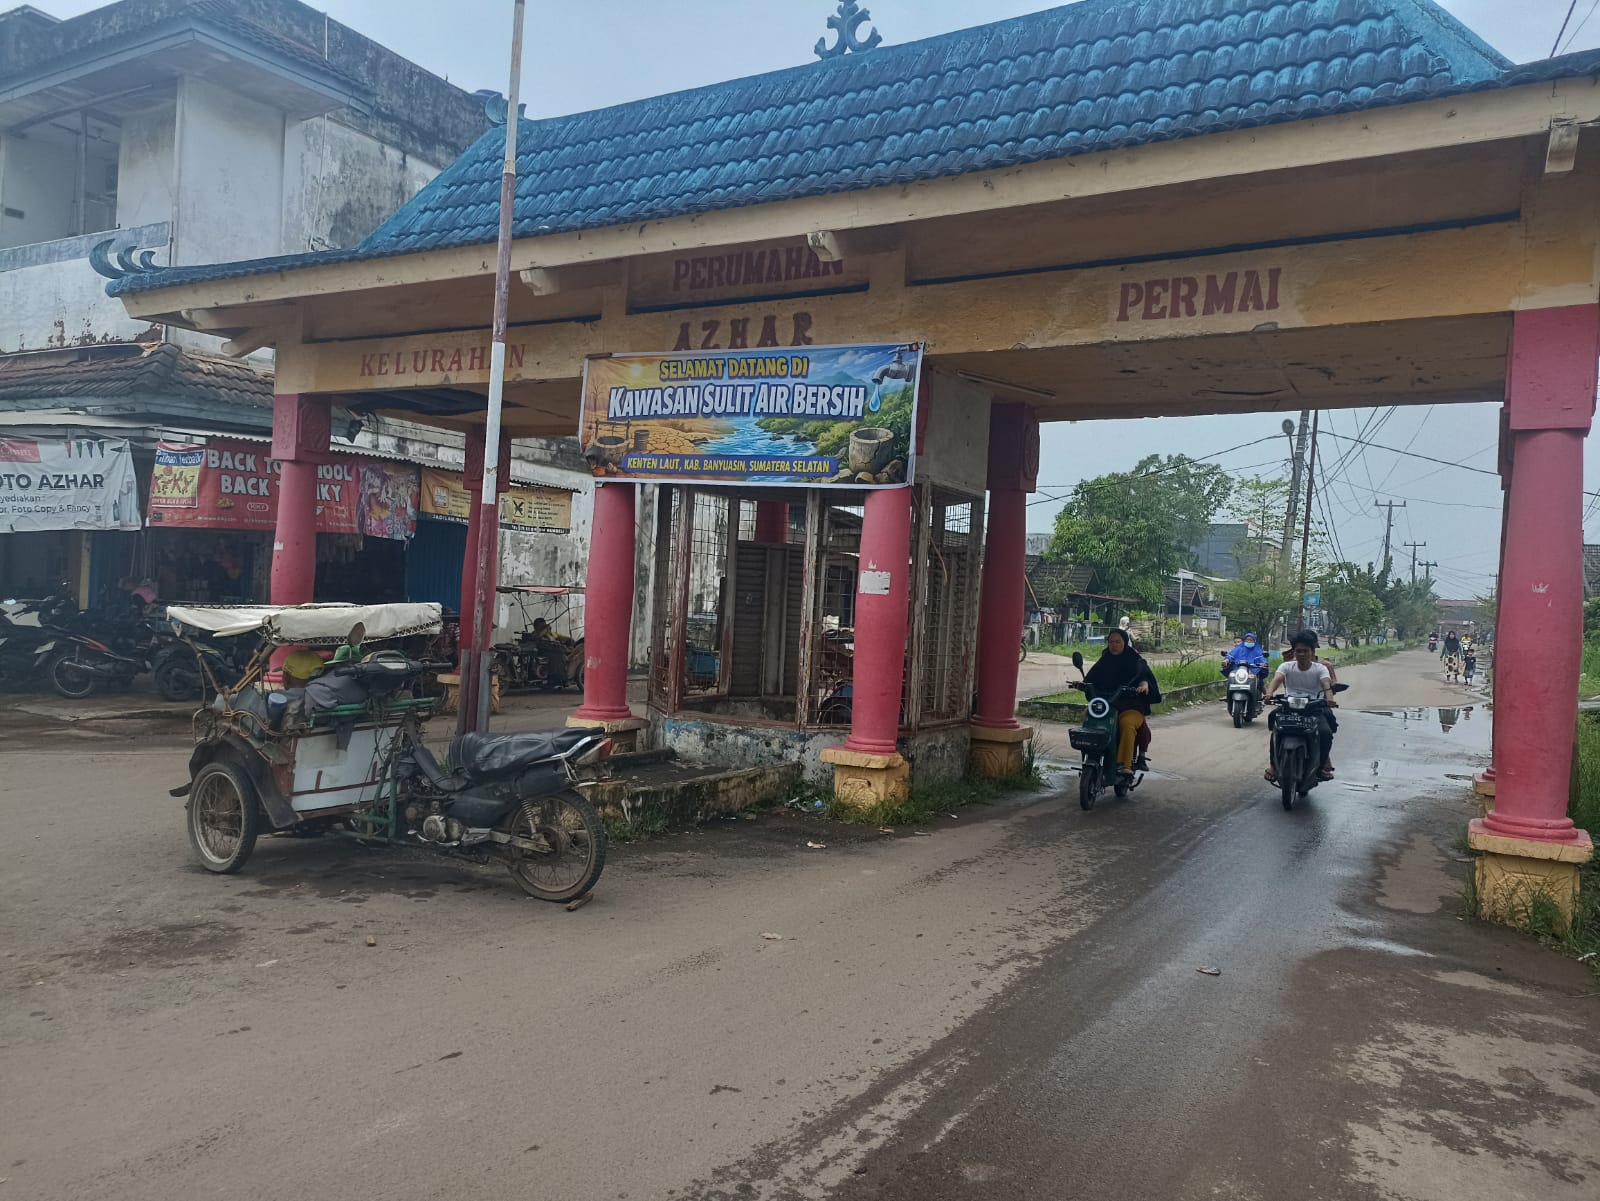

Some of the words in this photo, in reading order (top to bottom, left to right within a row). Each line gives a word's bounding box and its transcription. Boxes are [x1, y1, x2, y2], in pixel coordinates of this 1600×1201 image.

[1116, 267, 1282, 322] PERMAI
[672, 311, 813, 351] AZHAR
[360, 343, 527, 377] KELURAHN
[659, 358, 725, 380] SELAMAT
[728, 357, 788, 378] DATANG
[791, 356, 808, 376] DI
[608, 386, 699, 418] KAWASAN
[702, 383, 754, 414] SULIT
[755, 383, 790, 414] AIR
[792, 383, 866, 417] BERSIH
[207, 448, 257, 472] BACK
[627, 457, 657, 469] KENTEN
[659, 458, 682, 471] LAUT,
[684, 459, 701, 471] KAB.
[703, 459, 747, 472] BANYUASIN,
[749, 460, 790, 472] SUMATERA
[792, 460, 830, 473] SELATAN
[38, 473, 105, 489] AZHAR
[221, 474, 270, 496] BACK
[12, 505, 32, 513] Foto
[34, 504, 57, 515] Copy
[67, 504, 90, 513] Fancy
